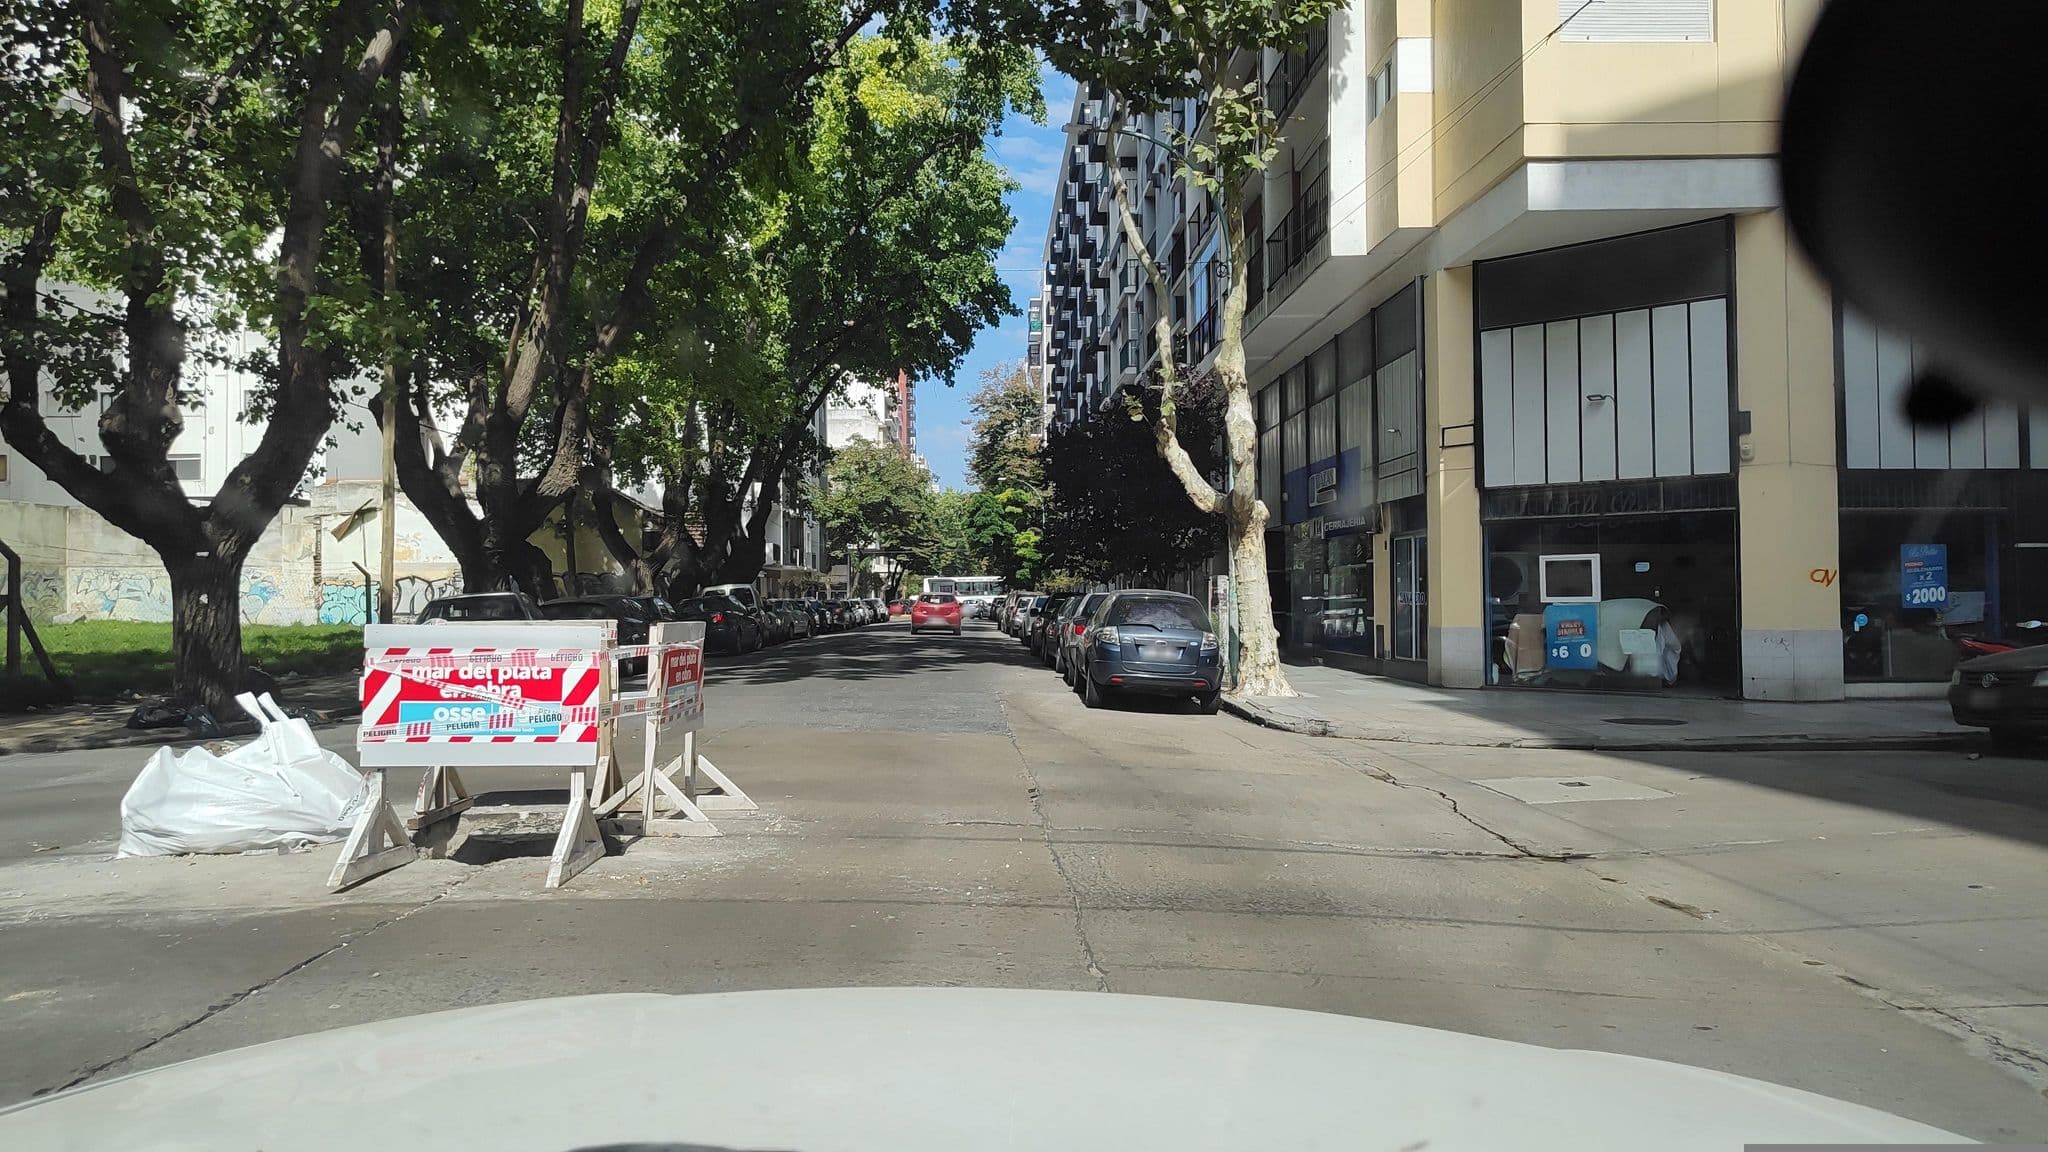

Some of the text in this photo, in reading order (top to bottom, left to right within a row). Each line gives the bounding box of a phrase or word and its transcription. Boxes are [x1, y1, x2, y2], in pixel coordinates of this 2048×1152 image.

[412, 663, 553, 684] mar del plata
[433, 706, 487, 723] osse
[529, 713, 562, 723] PELIGRO
[446, 720, 481, 731] PELIGRO
[363, 729, 398, 738] PELIGRO
